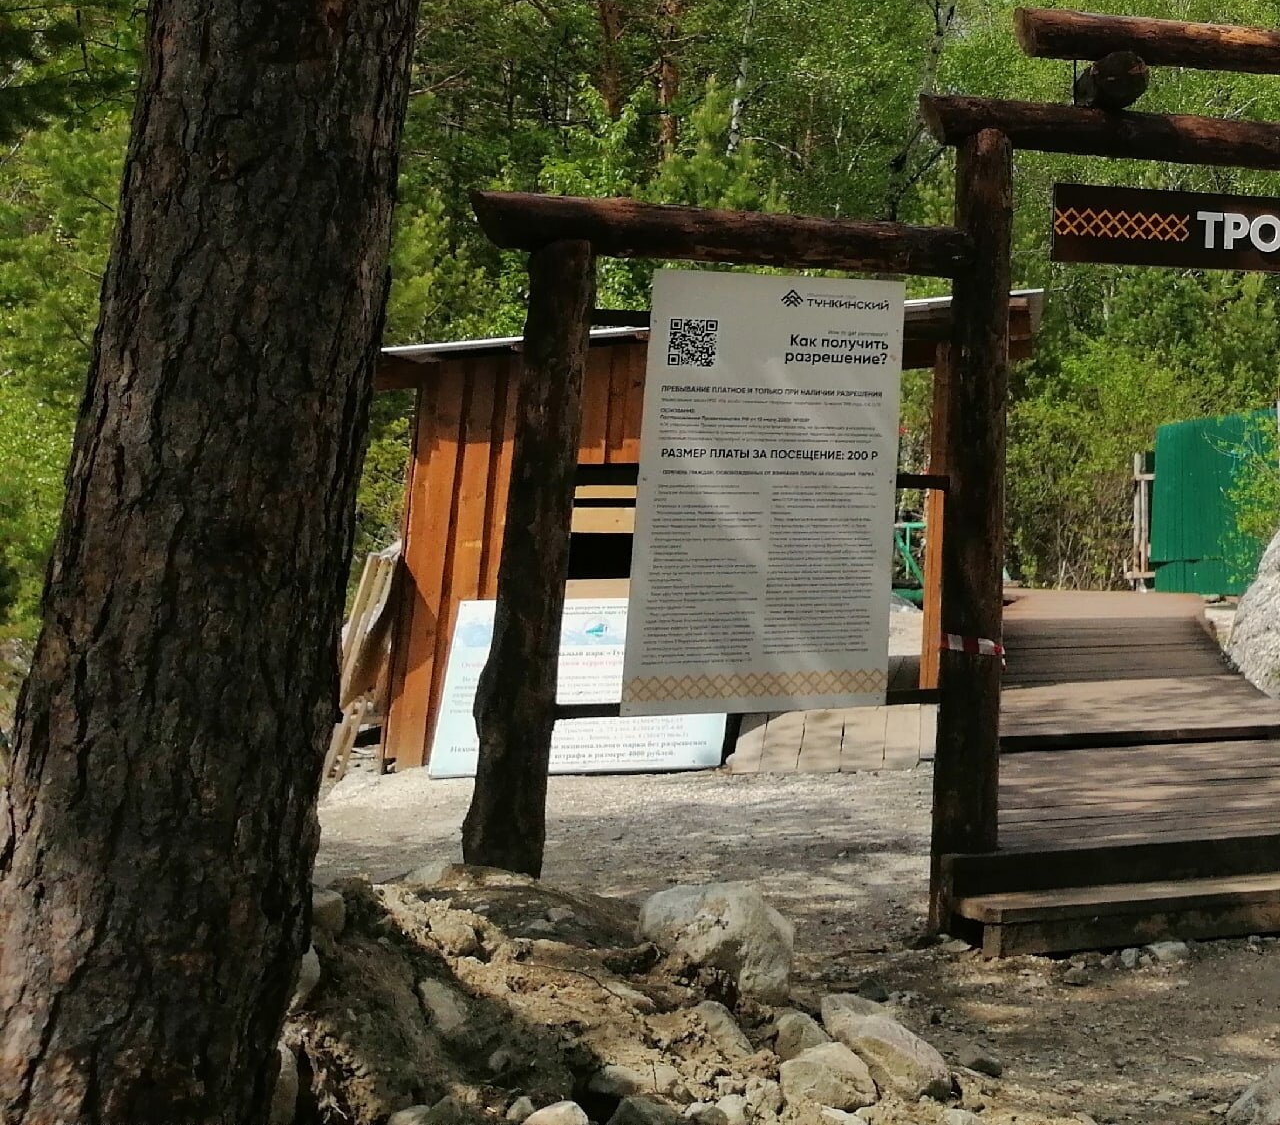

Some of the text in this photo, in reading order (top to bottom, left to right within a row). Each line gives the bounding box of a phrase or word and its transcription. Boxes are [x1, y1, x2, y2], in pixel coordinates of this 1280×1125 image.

[790, 334, 889, 351] Как получить
[784, 352, 888, 365] разрешение?
[661, 385, 711, 394] ПРЕБЫВАНИЕ
[712, 386, 746, 394] ПЛАТНОЕ
[755, 387, 783, 396] ТОЛЬКО
[785, 388, 799, 396] ПРИ
[837, 390, 882, 398] РАЗРЕШЕНИЯ
[661, 448, 707, 458] РАЗМЕР
[710, 449, 750, 459] ПЛАТЫ
[752, 449, 767, 459] ЗА
[770, 449, 845, 461] ПОСЕЩЕНИЕ:
[847, 451, 869, 461] 200
